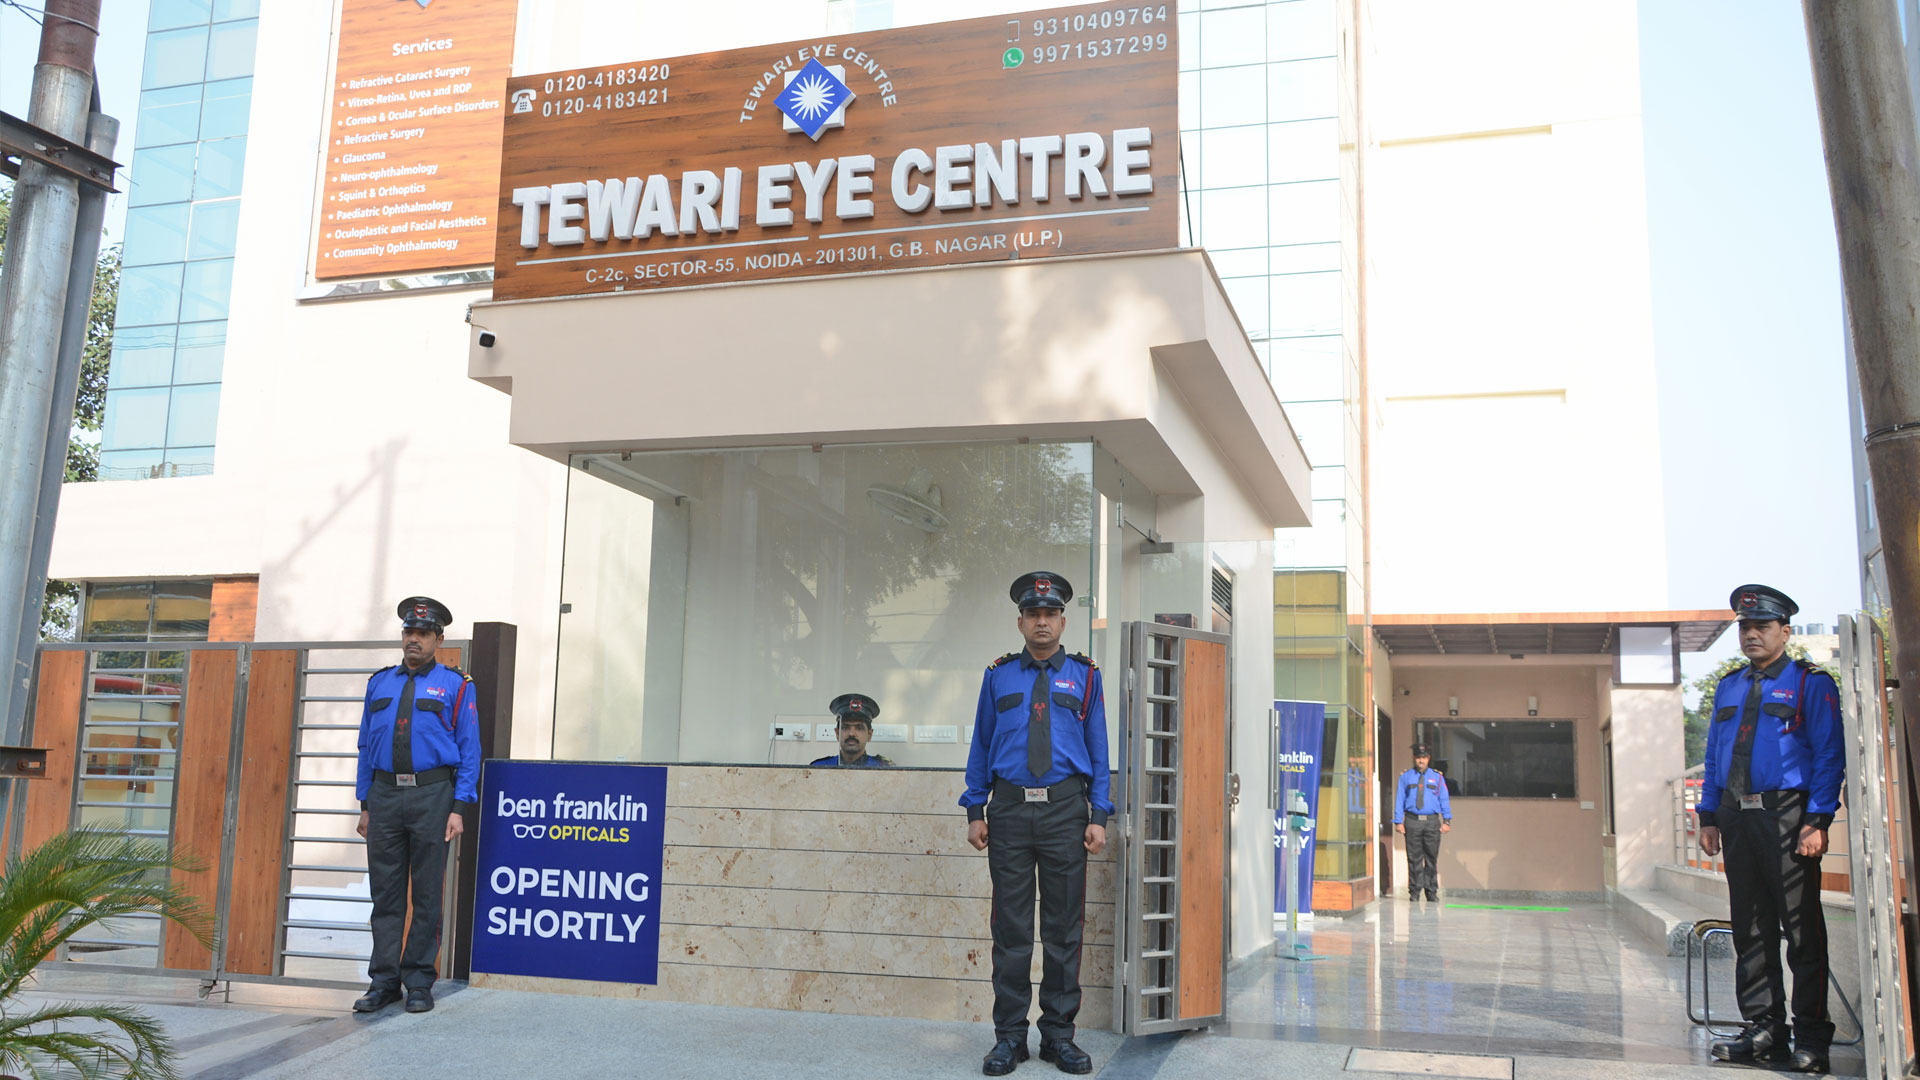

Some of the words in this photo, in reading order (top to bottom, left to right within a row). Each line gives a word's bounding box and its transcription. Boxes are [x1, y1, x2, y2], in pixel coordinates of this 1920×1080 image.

[1033, 5, 1167, 37] 9310409764
[392, 38, 453, 56] Services
[1033, 32, 1168, 64] 9971537299
[349, 75, 394, 89] Refractive
[395, 70, 433, 83] Cataract
[434, 66, 471, 79] Surgery
[544, 64, 670, 95] 0120-4183420
[739, 56, 793, 123] TEWARI
[798, 44, 837, 62] EYE
[842, 47, 897, 108] CENTRE
[348, 92, 407, 108] Vitreo-Retina,
[409, 88, 431, 100] Uvea
[433, 84, 451, 97] and
[452, 82, 472, 94] ROP
[542, 87, 669, 117] 0120-4183421
[345, 114, 377, 127] Cornea
[378, 111, 386, 122] &
[388, 109, 417, 121] Ocular
[418, 105, 453, 117] Surface
[454, 99, 499, 113] Disorders
[343, 130, 389, 145] Refractive
[390, 126, 425, 140] Surgery
[342, 151, 386, 164] Glaucoma
[340, 163, 439, 183] Neuro-ophthalmology
[338, 189, 367, 203] Squint
[369, 187, 377, 198] &
[378, 183, 426, 197] Orthoptics
[511, 165, 743, 249] TEWARI
[755, 154, 876, 228] EYE
[890, 127, 1153, 213] CENTRE
[336, 206, 380, 220] Paediatric
[382, 200, 453, 216] Ophthalmology
[334, 224, 389, 240] Oculoplastic
[390, 222, 409, 234] and
[410, 217, 436, 231] Facial
[438, 215, 487, 229] Aesthetics
[332, 243, 385, 259] Community
[386, 238, 459, 255] Ophthalmology
[585, 267, 630, 284] C-2c,
[633, 257, 741, 281] SECTOR-55,
[744, 252, 804, 270] NOIDA
[815, 245, 884, 265] 201301,
[888, 239, 930, 259] G.B.
[935, 233, 1007, 255] NAGAR
[1012, 228, 1063, 252] (U.P.)
[1278, 751, 1314, 764] anklin
[497, 790, 547, 819] ben
[552, 792, 648, 822] franklin
[548, 824, 630, 843] OPTICALS
[490, 865, 649, 902] OPENING
[487, 905, 647, 944] SHORTLY
